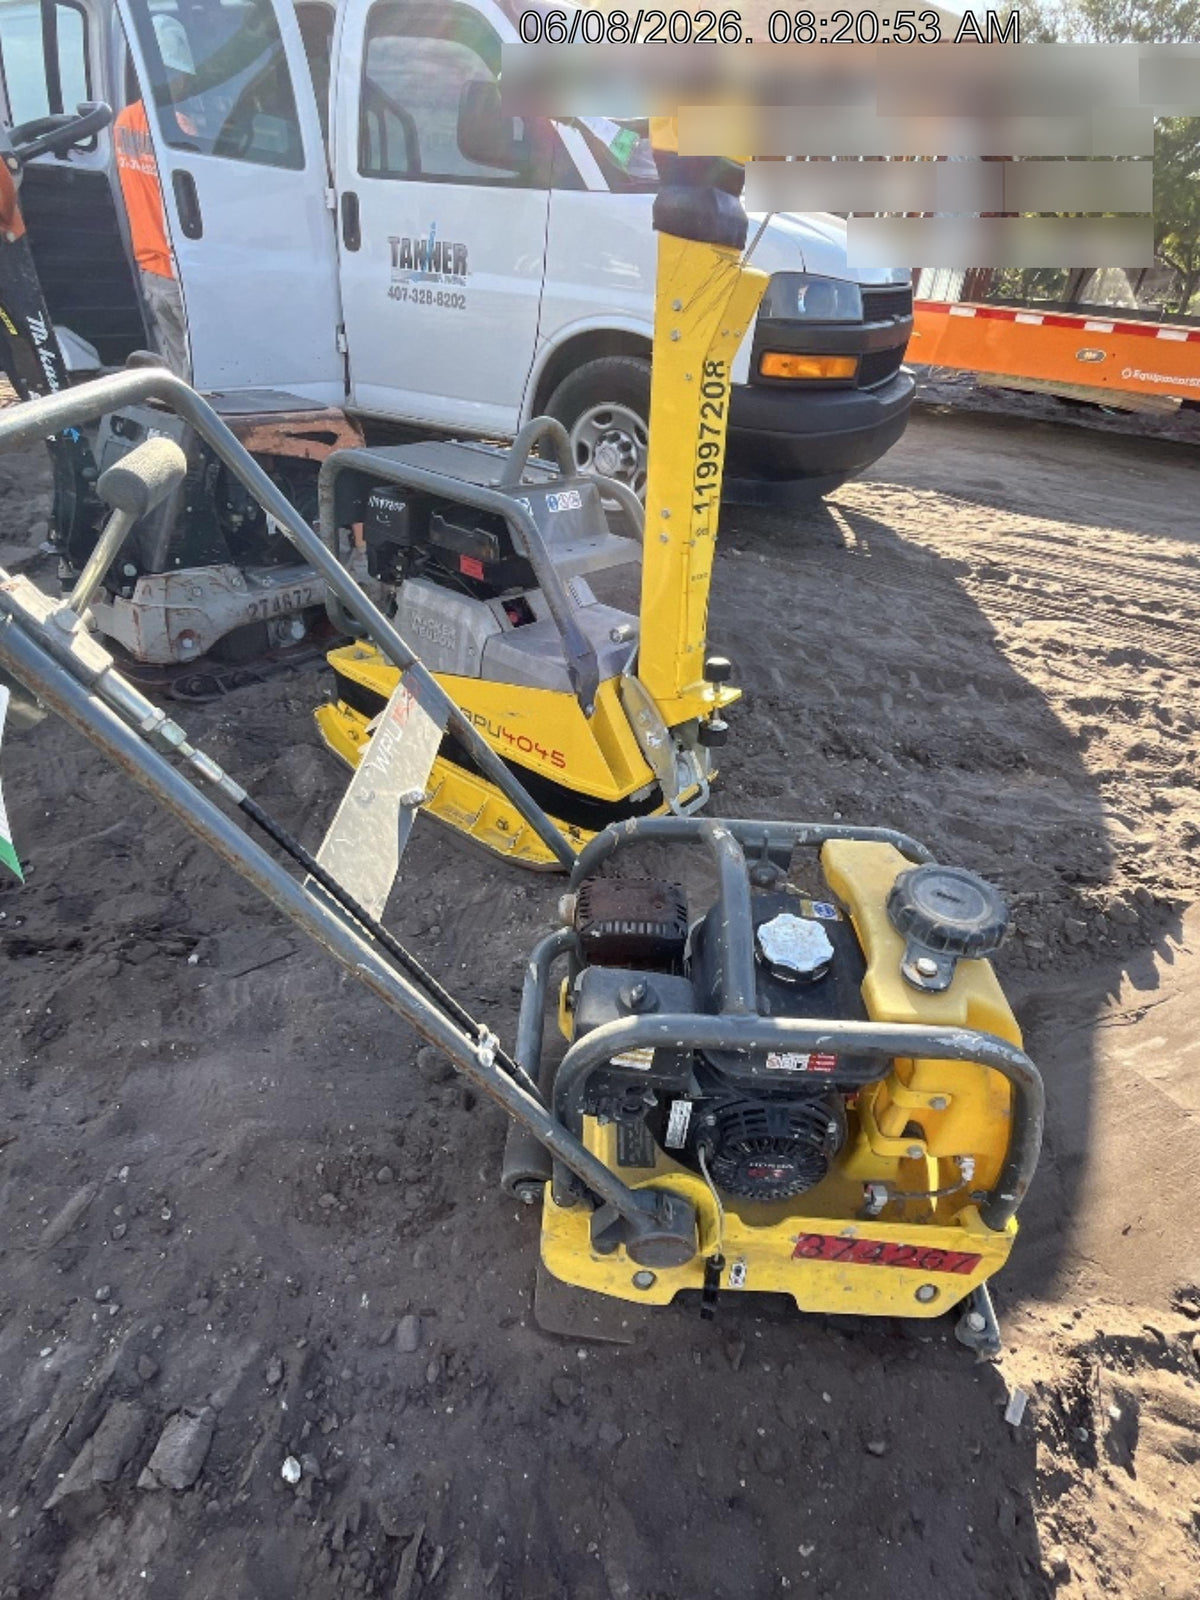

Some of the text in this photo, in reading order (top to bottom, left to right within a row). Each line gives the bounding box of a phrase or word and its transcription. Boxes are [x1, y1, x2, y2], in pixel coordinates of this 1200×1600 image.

[387, 235, 468, 276] TANNER
[387, 286, 467, 310] 407-328-8202
[693, 359, 726, 515] 11997208
[801, 1233, 981, 1272] 374267
